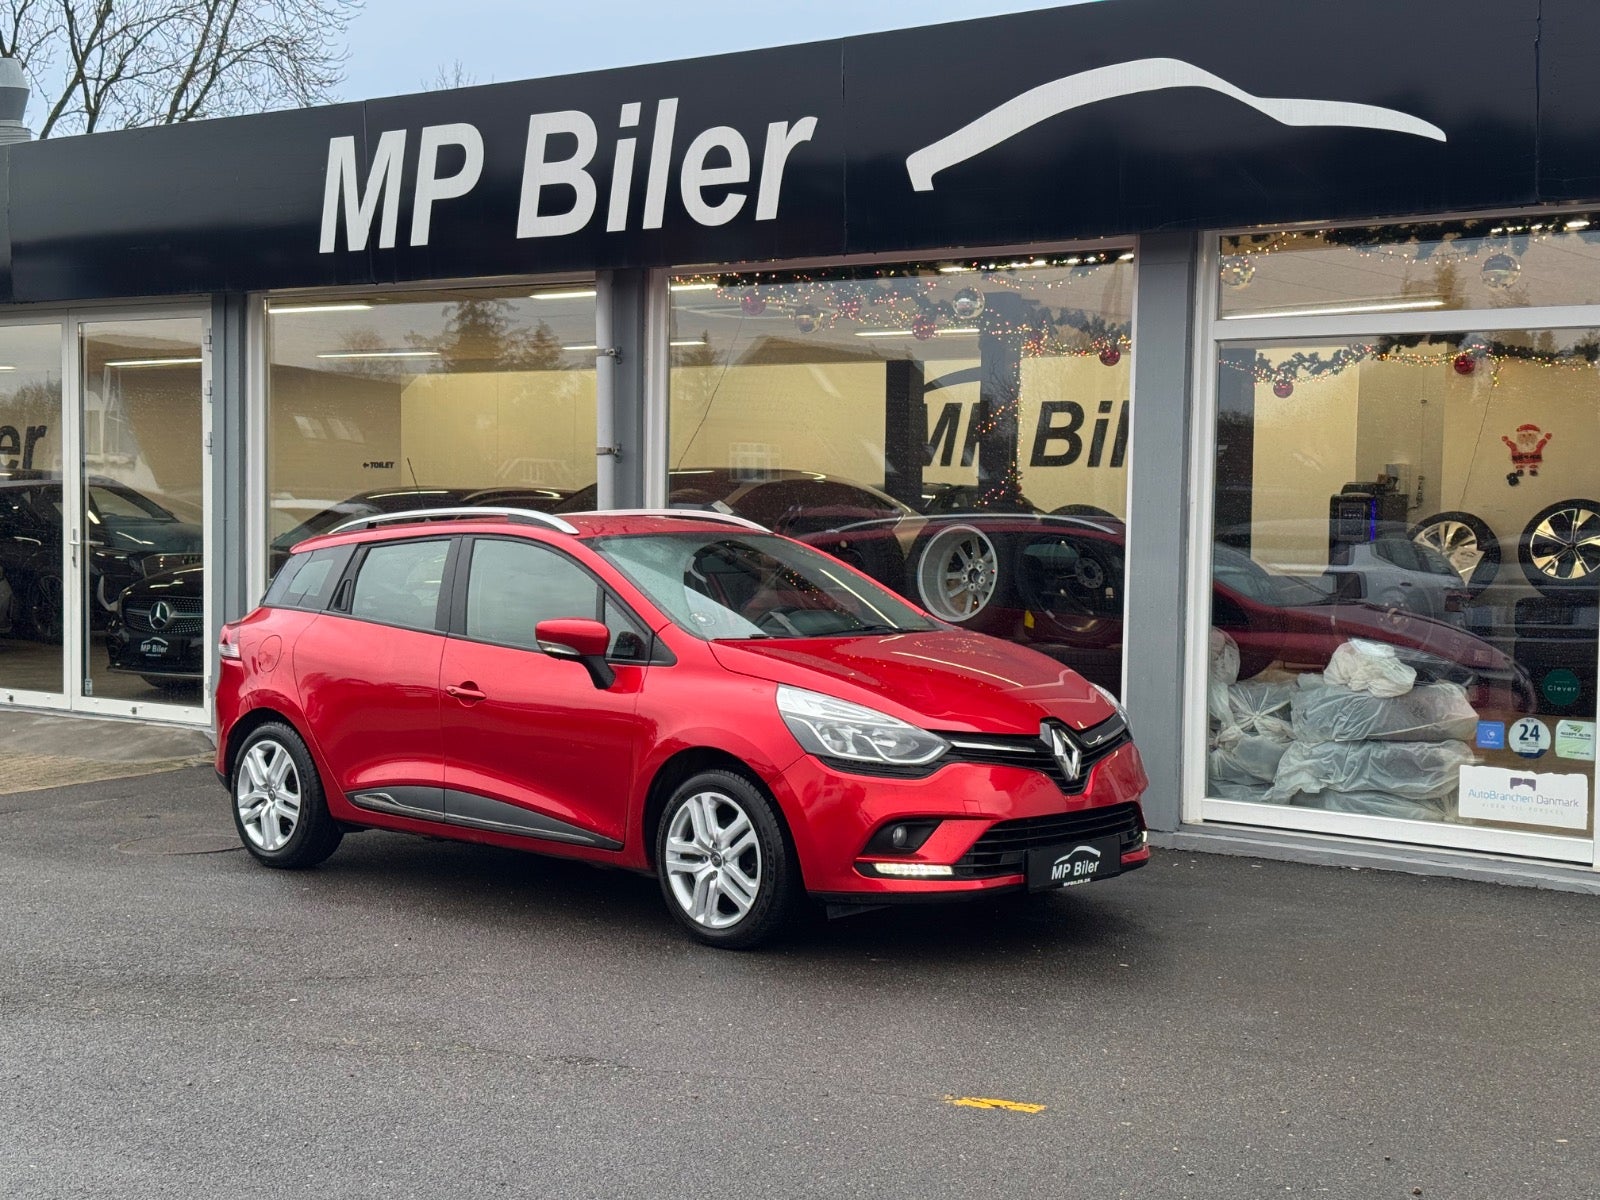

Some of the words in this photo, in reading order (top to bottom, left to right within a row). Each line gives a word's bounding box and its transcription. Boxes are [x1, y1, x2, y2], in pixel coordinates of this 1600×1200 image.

[319, 122, 485, 254] MP
[516, 97, 818, 239] Biler
[370, 461, 395, 469] TOILET
[140, 644, 151, 652] MP
[152, 644, 168, 653] Biler
[1547, 684, 1576, 692] Clever
[1519, 723, 1540, 742] 24
[1468, 788, 1534, 804] AutoBranchen
[1536, 794, 1580, 808] Danmark
[1051, 863, 1071, 880] MP
[1073, 860, 1100, 876] Biler
